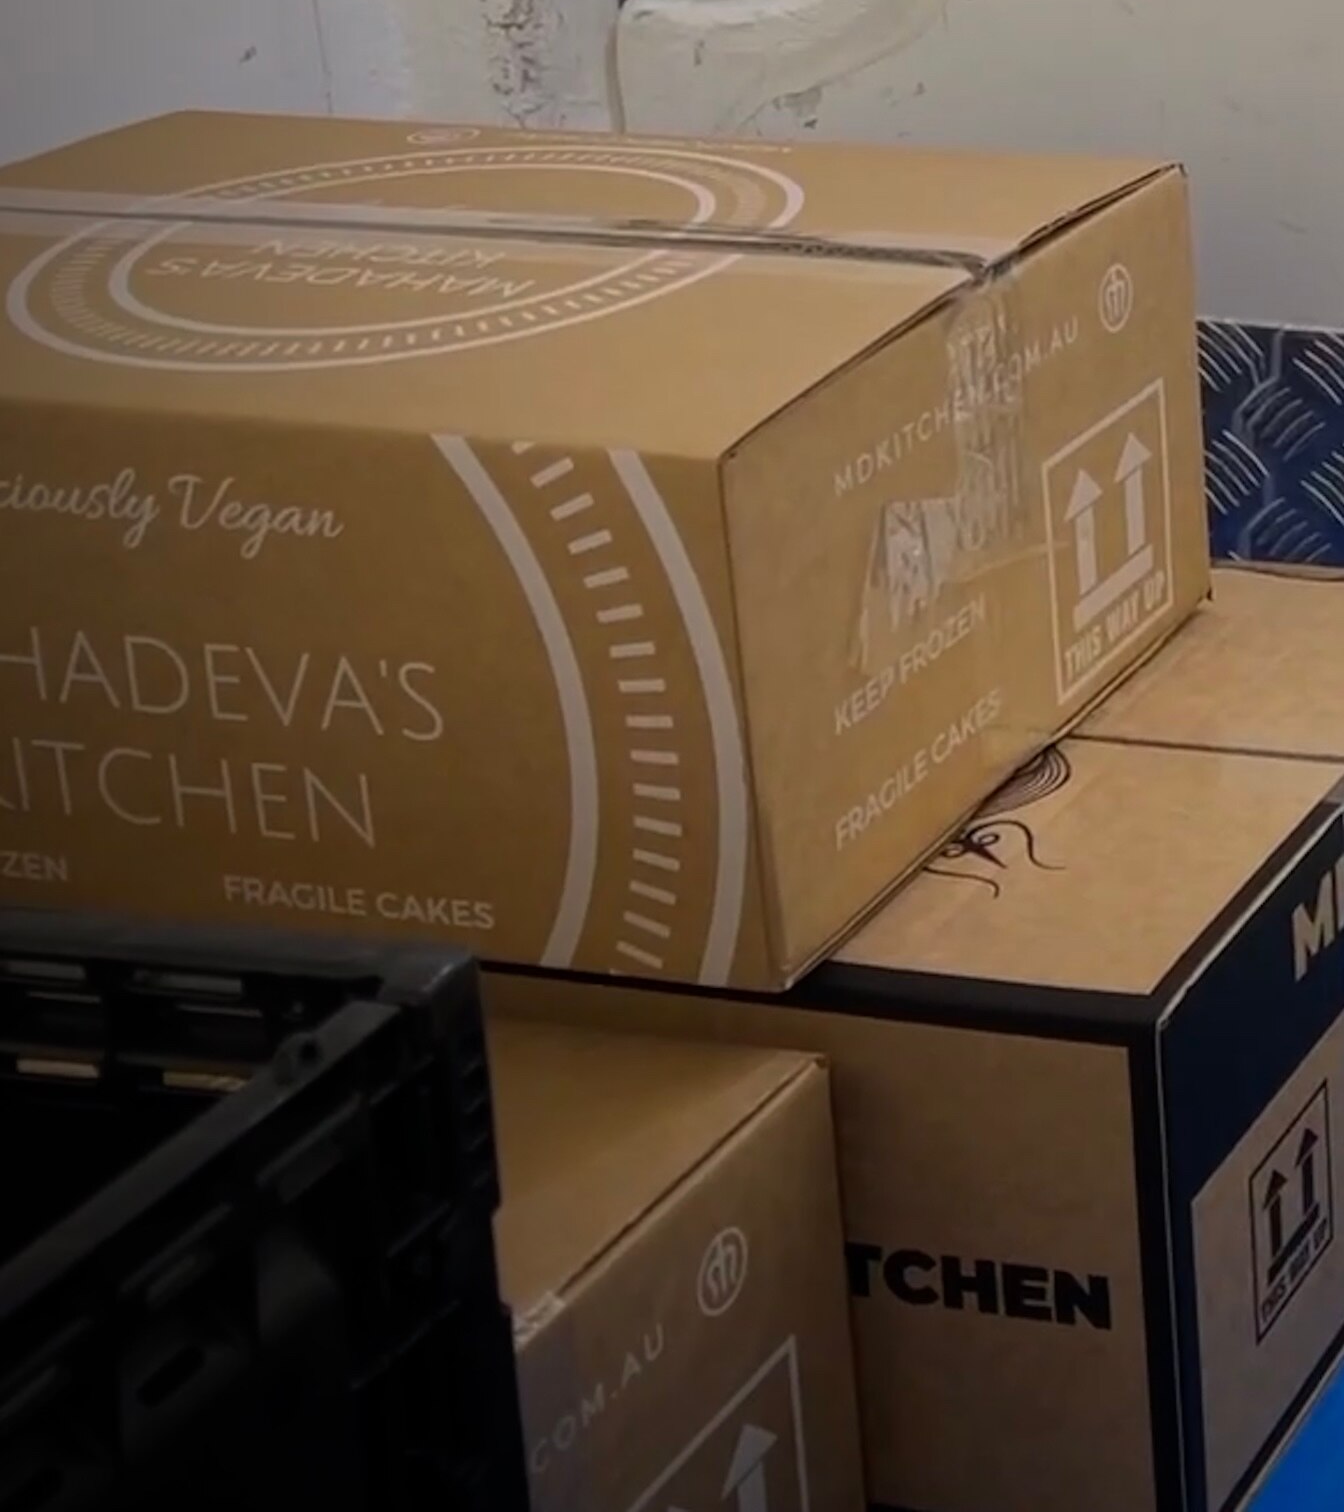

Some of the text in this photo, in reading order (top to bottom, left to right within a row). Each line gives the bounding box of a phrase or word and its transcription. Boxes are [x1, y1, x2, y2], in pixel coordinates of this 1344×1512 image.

[168, 473, 345, 560] Vegan
[833, 592, 986, 736] KEEP FROZEN
[1065, 573, 1167, 679] THIS WAY UP
[0, 625, 444, 742] HADEVA'S
[0, 736, 376, 849] ITCHEN
[835, 687, 1001, 851] FRAGILE CAKES
[1, 849, 69, 882] ZEN
[223, 874, 496, 930] FRAGILE CAKES
[843, 1240, 1112, 1331] TCHEN
